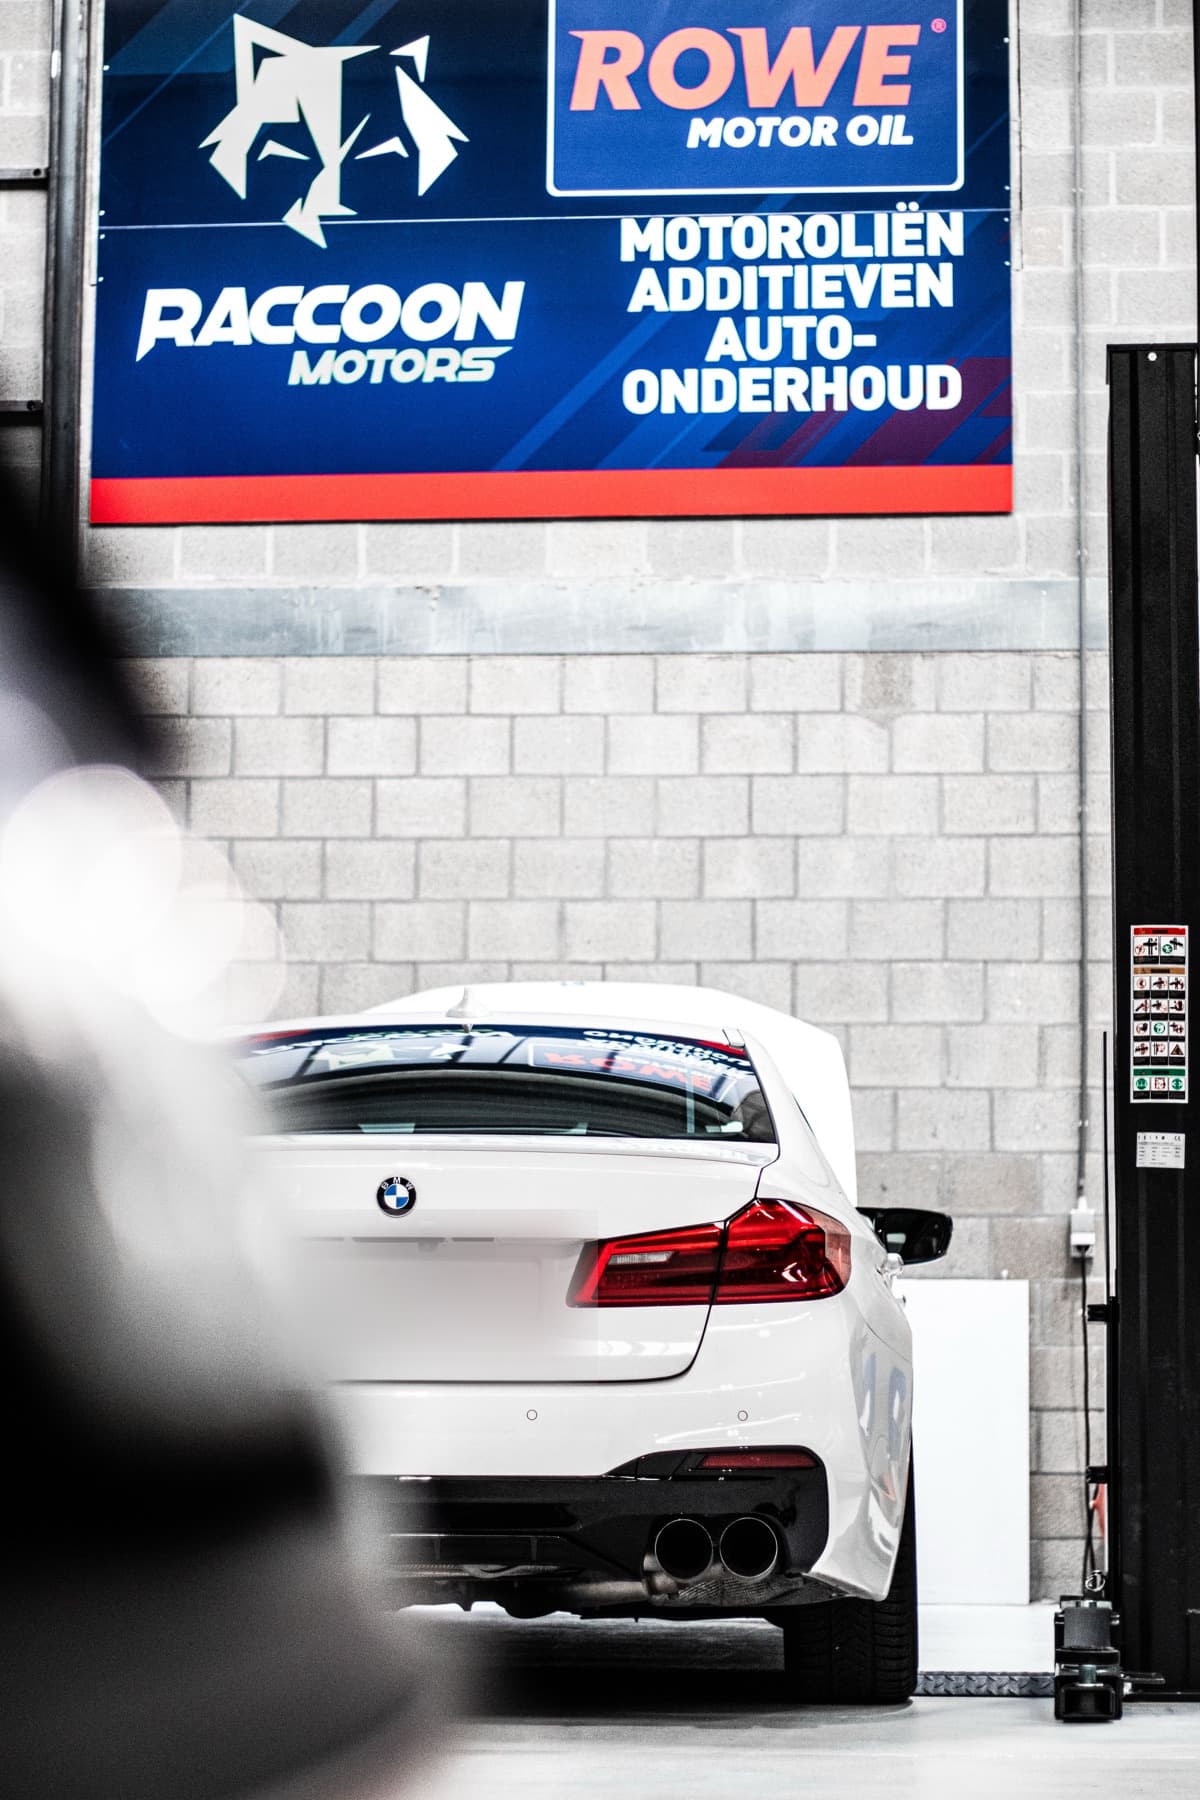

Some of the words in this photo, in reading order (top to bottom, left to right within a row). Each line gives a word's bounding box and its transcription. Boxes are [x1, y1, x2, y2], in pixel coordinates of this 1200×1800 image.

[568, 24, 922, 111] ROWE
[686, 115, 838, 148] MOTOR
[845, 114, 914, 146] OIL
[619, 201, 965, 262] MOTOROLIËN
[626, 262, 955, 313] ADDITIEVEN
[136, 281, 526, 362] RACCOON
[704, 314, 877, 362] AUTO-
[287, 346, 513, 386] MOTORS
[621, 364, 963, 415] ONDERHOUD
[381, 1176, 415, 1190] BMW
